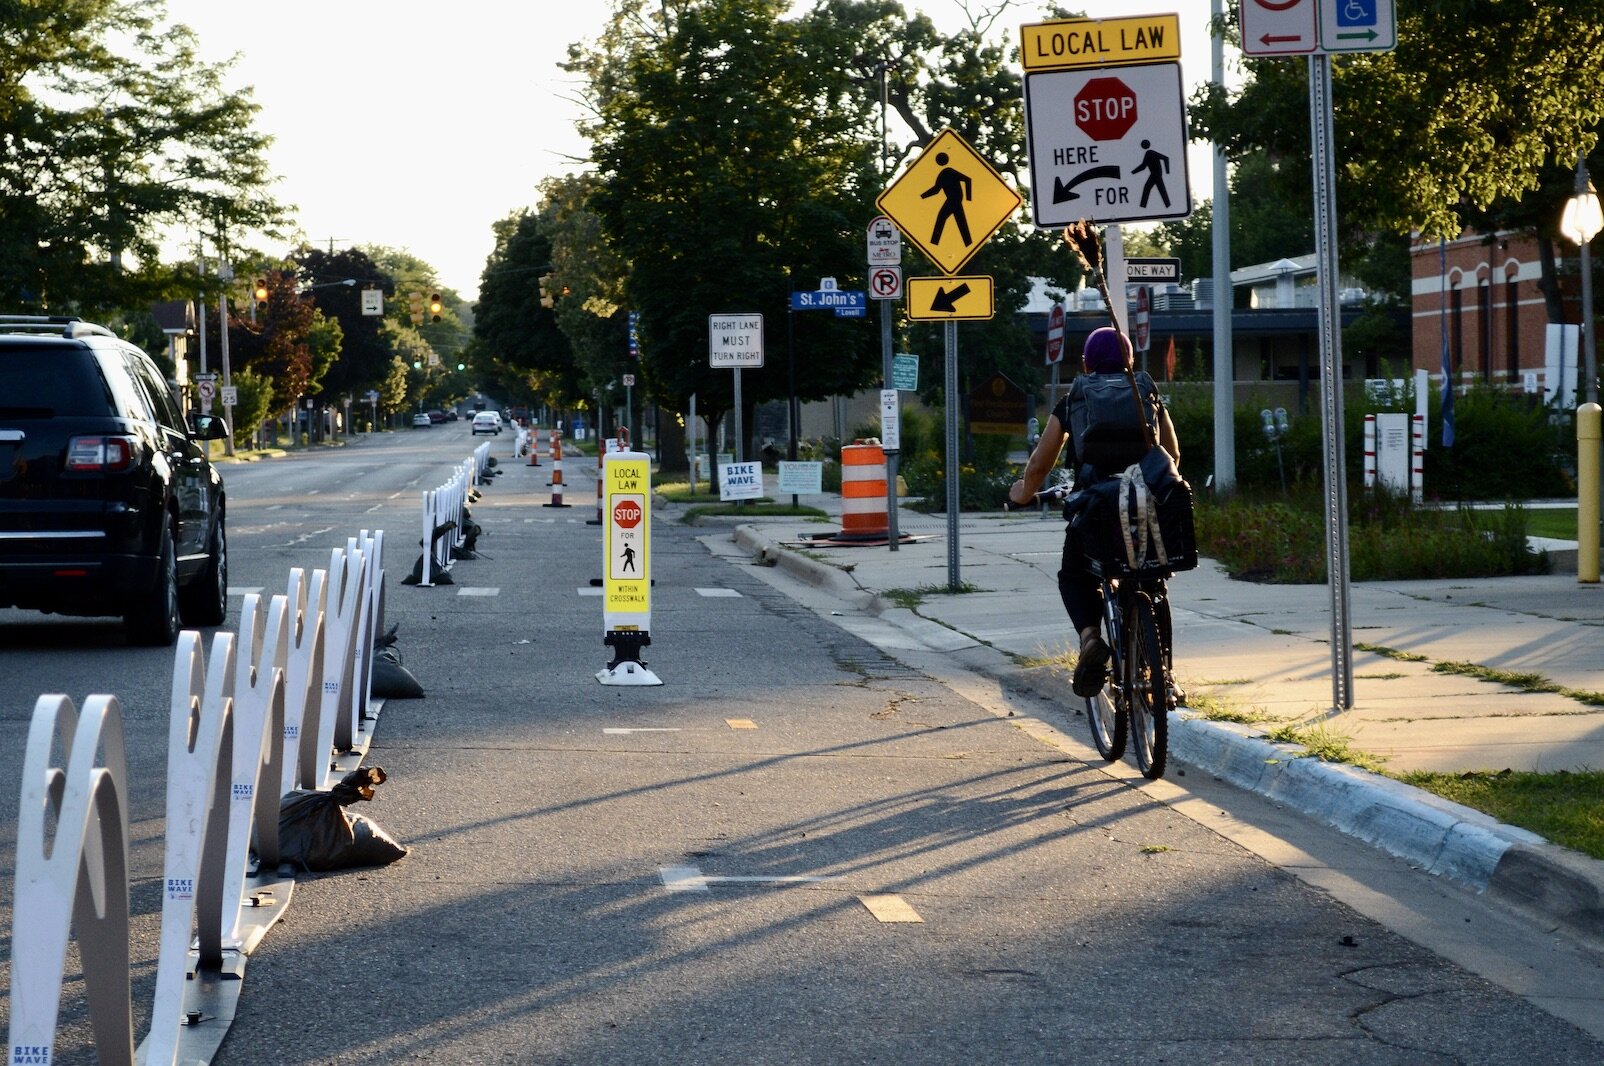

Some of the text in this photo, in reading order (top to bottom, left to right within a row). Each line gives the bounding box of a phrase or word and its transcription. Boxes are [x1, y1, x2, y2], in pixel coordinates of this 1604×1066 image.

[1037, 26, 1164, 57] LOCAL LAW
[1077, 97, 1134, 122] STOP
[1054, 146, 1099, 165] HERE
[1095, 187, 1129, 205] FOR
[1126, 265, 1173, 276] ONE WAY
[800, 293, 816, 305] St.
[819, 293, 857, 305] John's
[713, 321, 760, 330] RIGHT LANE
[722, 335, 750, 346] MUST
[713, 351, 760, 361] TURN RIGHT
[223, 396, 236, 404] 25
[614, 468, 641, 479] LOCAL
[727, 465, 755, 475] BIKE
[618, 481, 638, 490] LAW
[727, 476, 755, 485] WAVE
[615, 508, 641, 521] STOP
[15, 1046, 49, 1056] BIKE
[14, 1056, 48, 1065] WAVE
